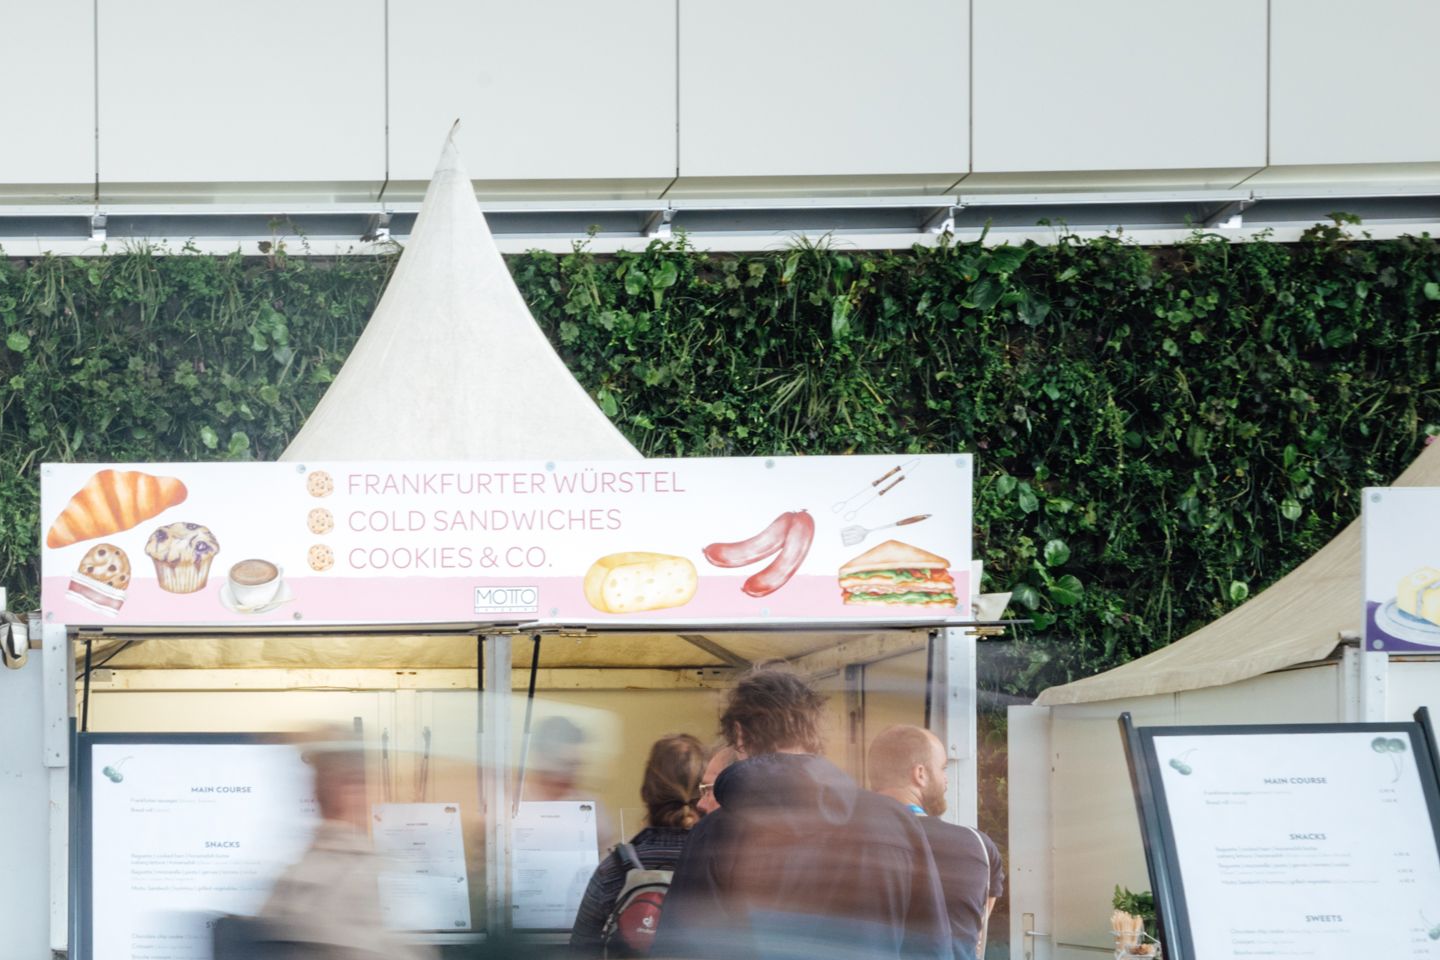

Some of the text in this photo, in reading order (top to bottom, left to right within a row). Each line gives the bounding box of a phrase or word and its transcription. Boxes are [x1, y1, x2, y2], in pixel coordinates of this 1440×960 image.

[348, 468, 686, 495] FRANKFURTER WÜRSTEL
[348, 509, 622, 532] COLD SANDWICHES
[348, 546, 553, 569] COOKIES & CO.
[476, 588, 537, 605] MOTTO
[1263, 777, 1288, 785] MAIN
[1289, 833, 1327, 841] SNACKS
[1305, 914, 1343, 922] SWEETS
